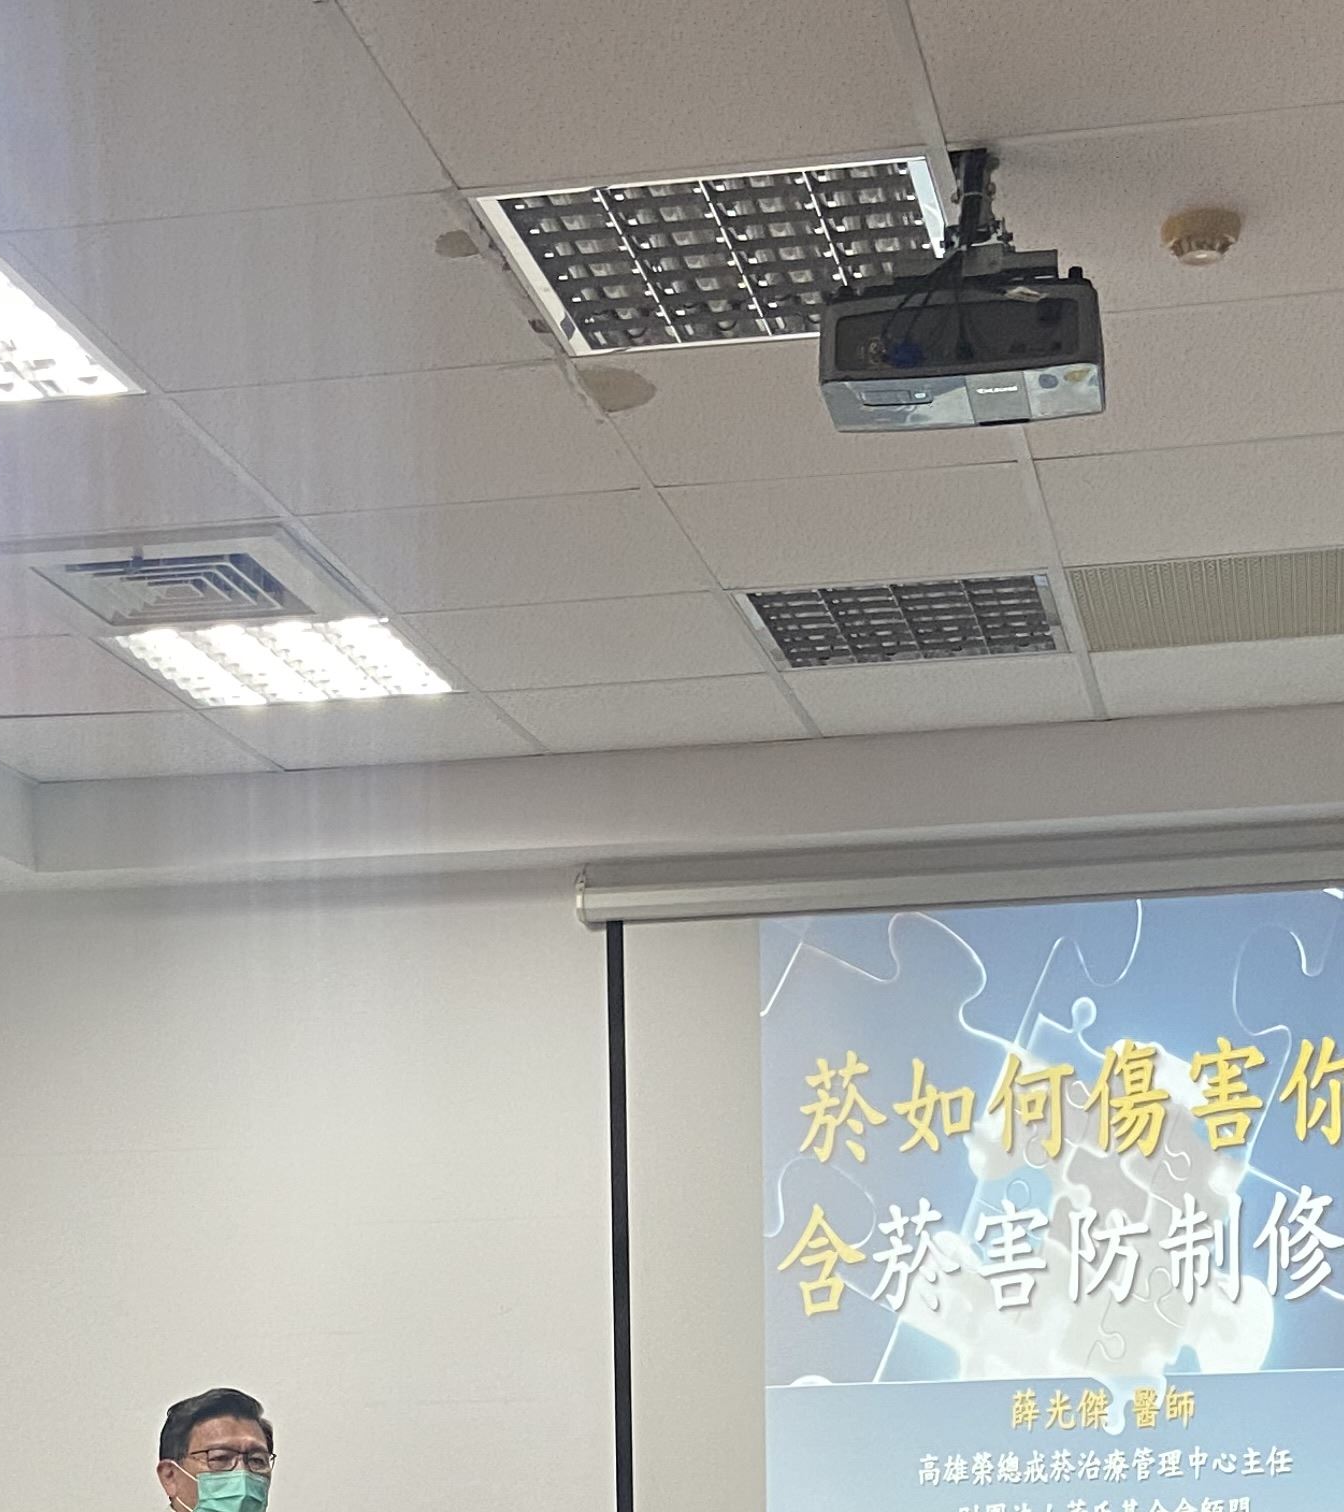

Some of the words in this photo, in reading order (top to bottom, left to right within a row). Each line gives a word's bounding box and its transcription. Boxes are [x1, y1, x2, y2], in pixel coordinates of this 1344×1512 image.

[1010, 1390, 1109, 1431] 薛光傑
[1131, 1386, 1196, 1428] 醫師
[918, 1446, 1294, 1488] 高雄榮總戒菸治療管理中心主任
